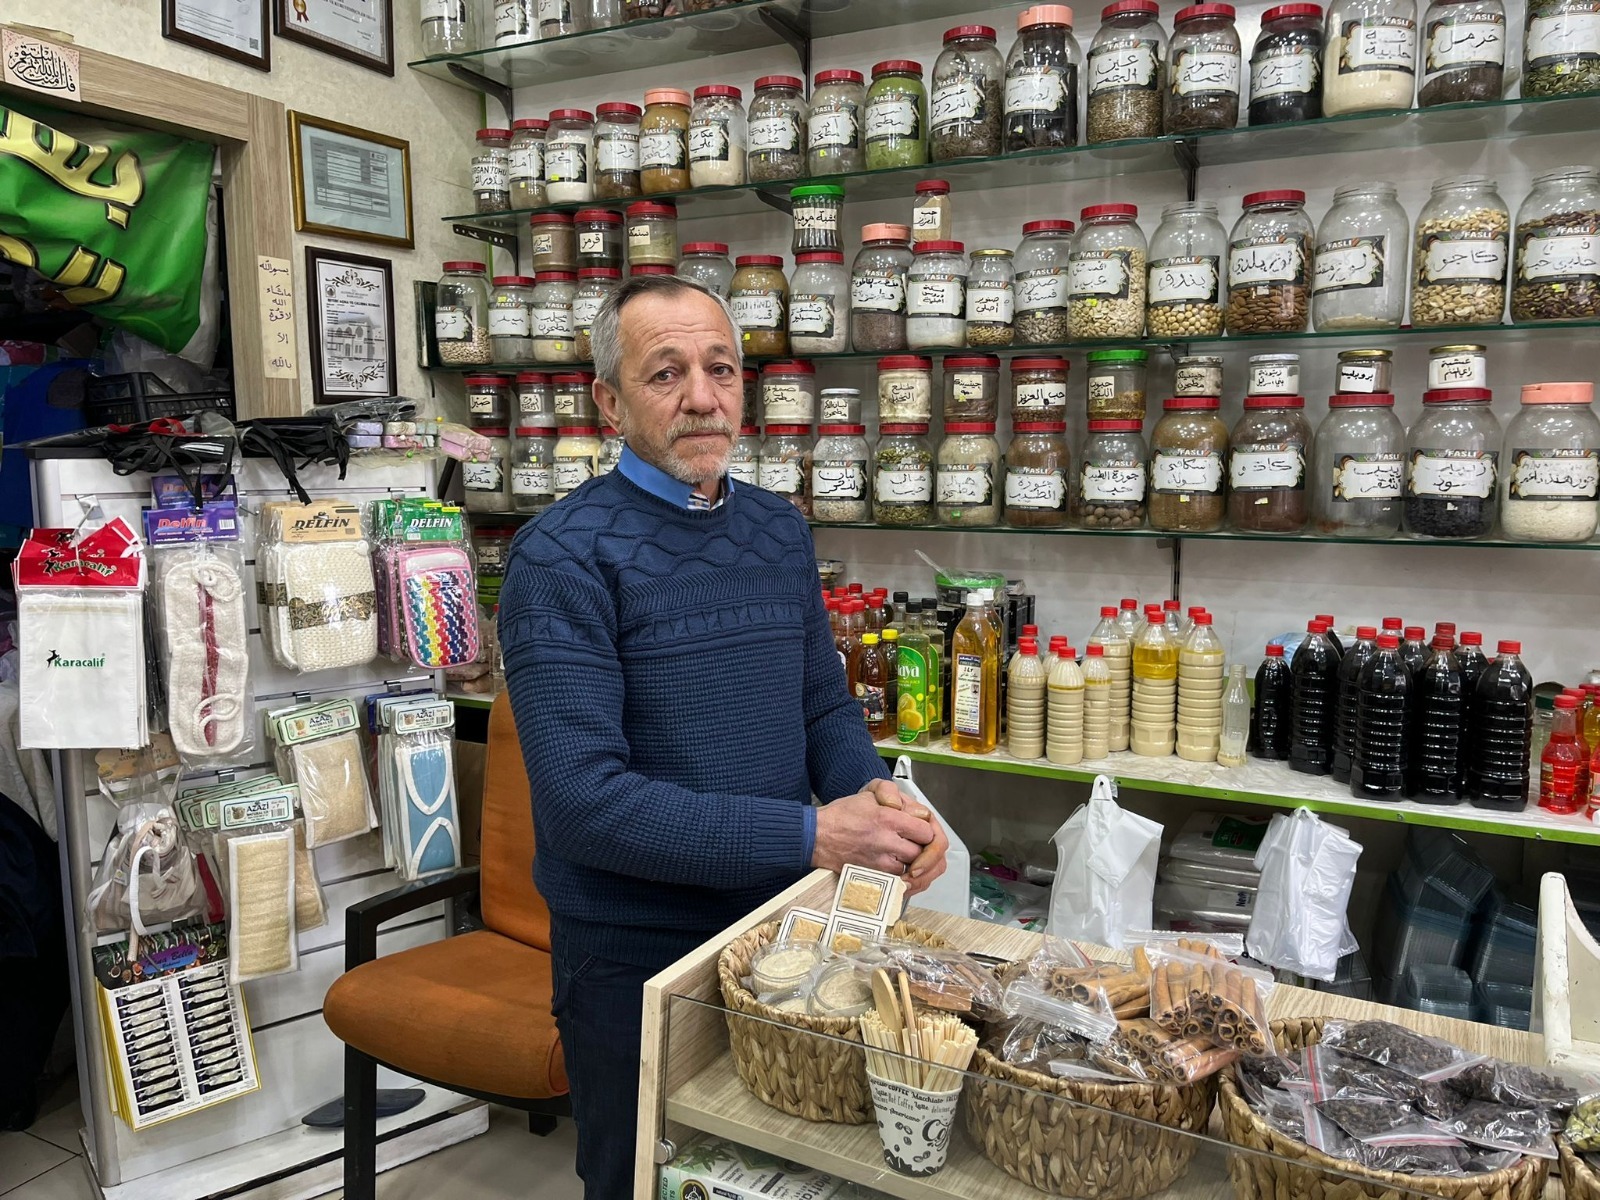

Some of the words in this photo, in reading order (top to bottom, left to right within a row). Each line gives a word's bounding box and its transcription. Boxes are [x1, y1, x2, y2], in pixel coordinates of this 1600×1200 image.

[1563, 3, 1593, 12] FASLI
[1385, 17, 1409, 26] FASLI
[1468, 13, 1495, 21] FASLI
[1211, 43, 1234, 52] FASLI
[1560, 226, 1590, 234] FASLI
[582, 234, 601, 249] قرمز
[1252, 235, 1279, 244] FASLI
[1081, 251, 1105, 259] FASLI
[1170, 256, 1195, 264] FASLI
[1436, 249, 1499, 272] كاجو
[1030, 268, 1054, 276] FASLI
[1158, 270, 1206, 291] بندق
[1448, 450, 1477, 458] FASLI
[1557, 449, 1584, 457] FASLI
[818, 469, 855, 480] لبان
[157, 517, 207, 528] Delfin
[294, 517, 350, 530] DELFİN
[410, 516, 454, 528] DELFİN
[54, 560, 112, 577] Karacalif
[54, 657, 105, 668] Karacalif
[911, 1092, 944, 1103] Macchiato
[889, 1108, 920, 1122] Americano
